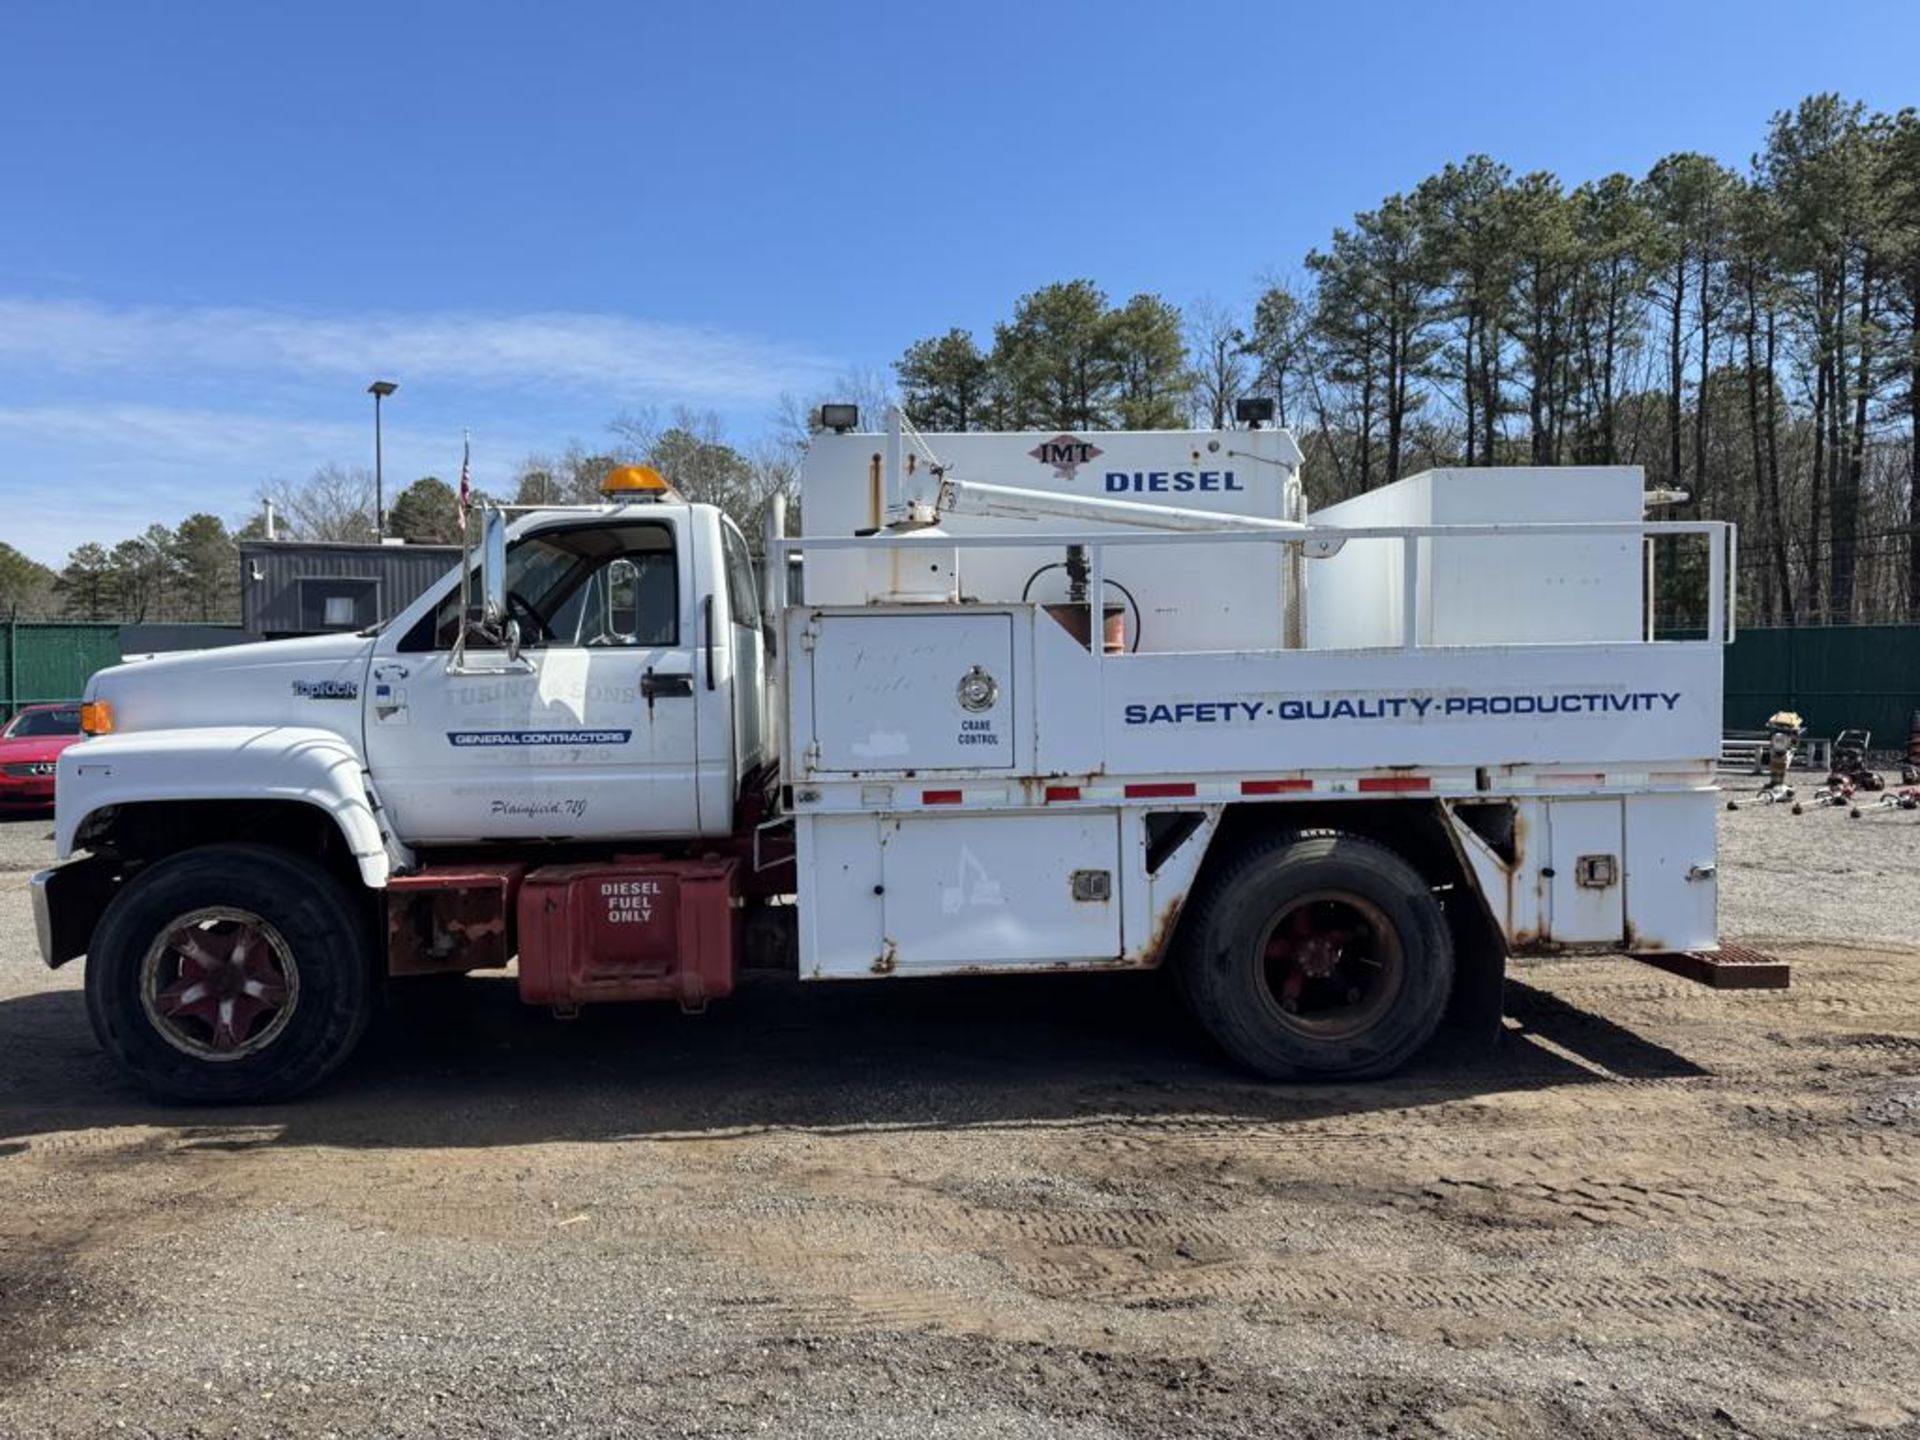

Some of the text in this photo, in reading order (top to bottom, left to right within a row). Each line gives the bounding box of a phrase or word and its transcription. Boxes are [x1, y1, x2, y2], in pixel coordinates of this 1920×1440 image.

[1039, 443, 1093, 464] IMT
[1105, 471, 1244, 493] DIESEL
[1124, 692, 1681, 725] SAFETY QUALITY PRODUCTIVITY
[961, 720, 991, 732] CRANE
[455, 732, 625, 745] GENERAL CONTRACTORS
[958, 733, 999, 745] CONTROL
[600, 881, 662, 896] DIESEL
[608, 896, 652, 909] FUEL
[608, 909, 652, 923] ONLY
